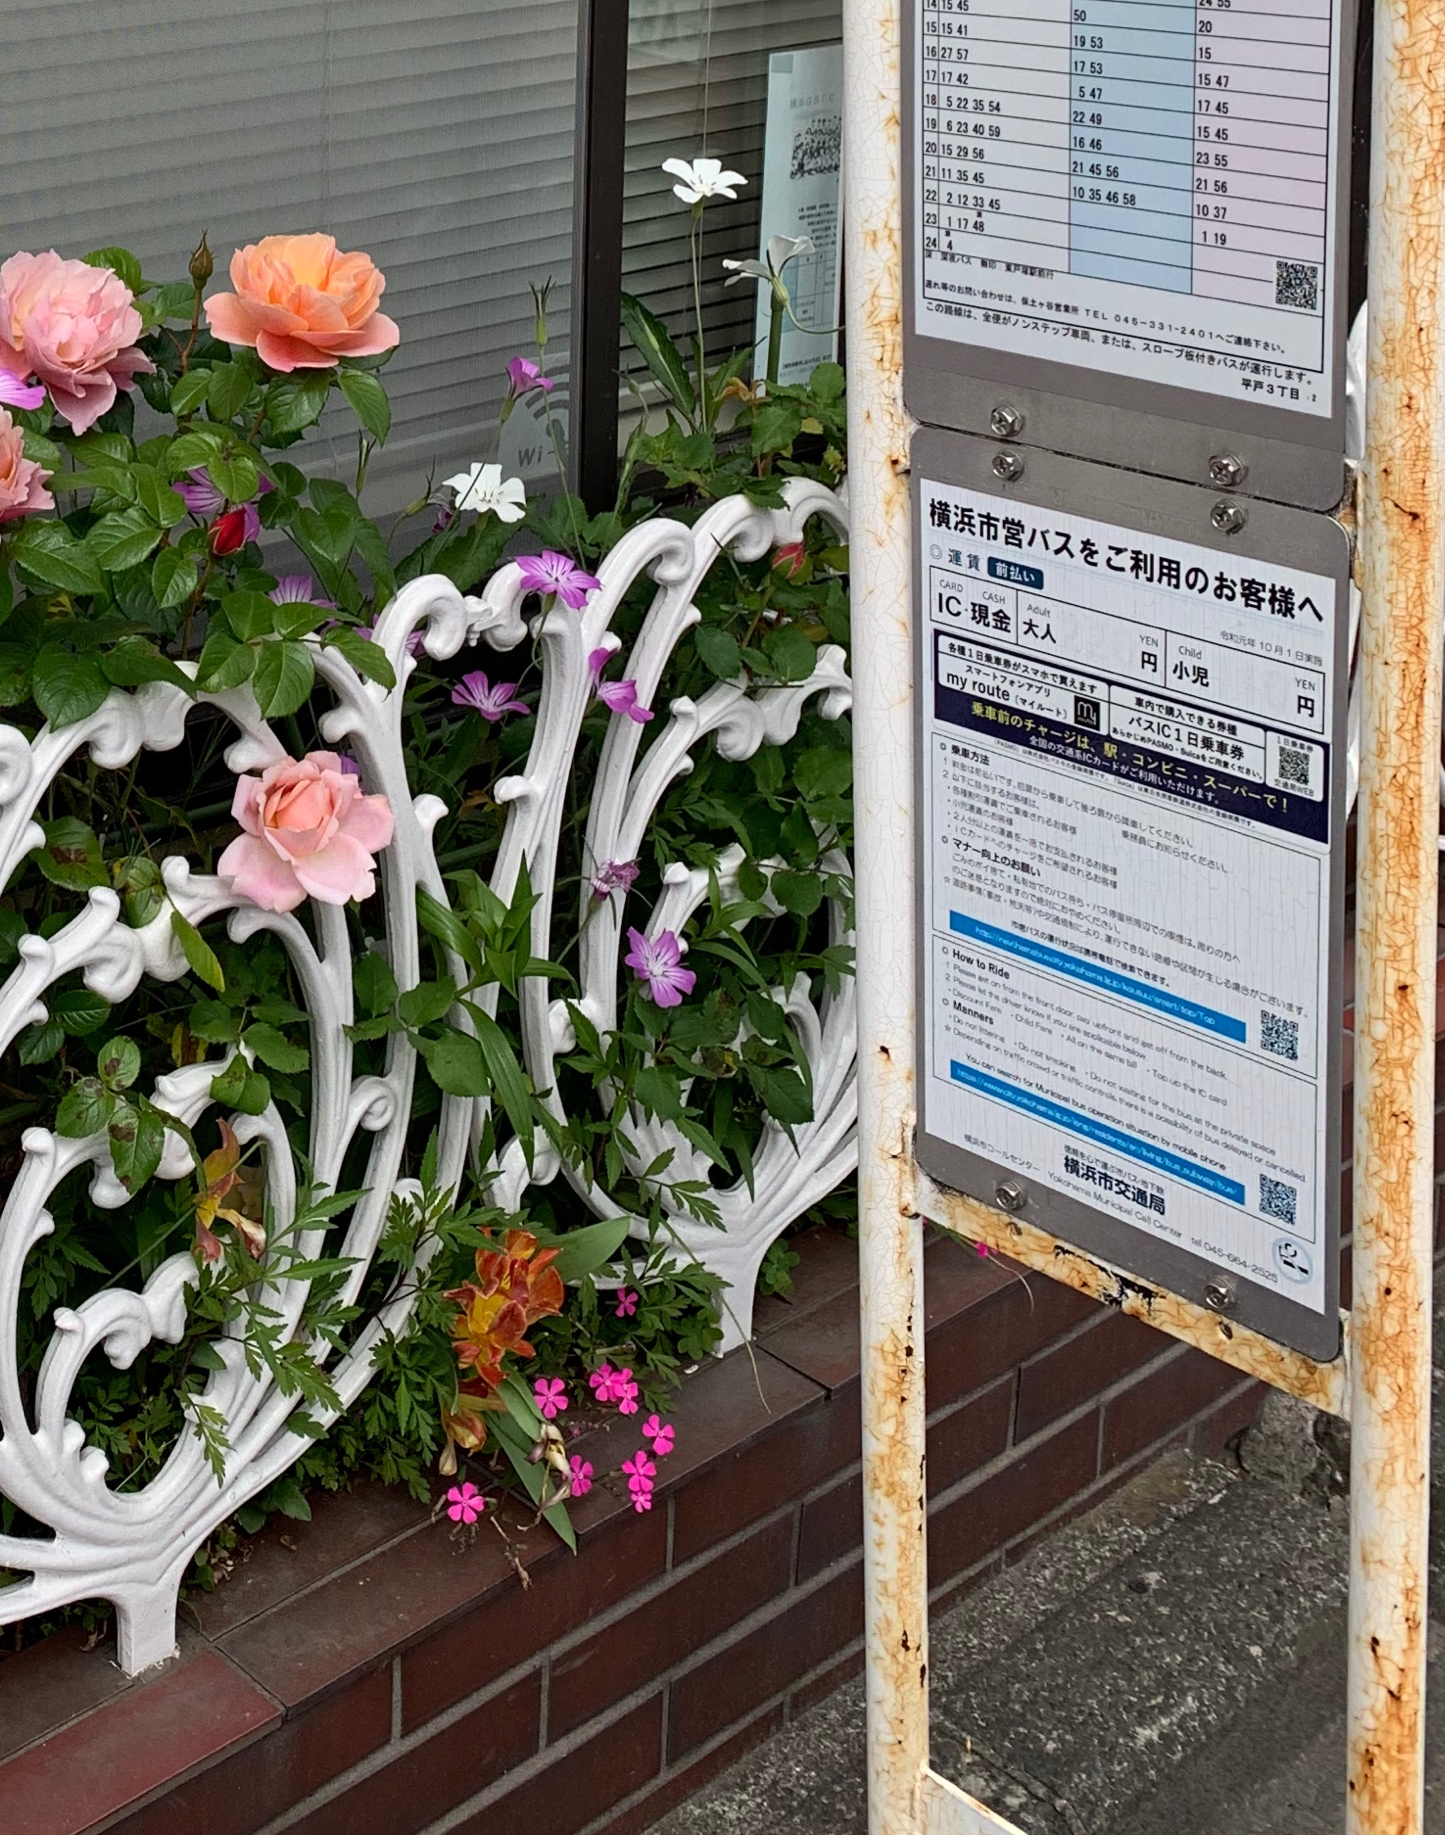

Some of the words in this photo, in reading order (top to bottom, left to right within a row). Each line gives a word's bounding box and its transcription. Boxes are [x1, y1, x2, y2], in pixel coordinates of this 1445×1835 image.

[926, 165, 936, 177] 21
[942, 168, 952, 179] 11
[957, 170, 969, 182] 35
[973, 172, 985, 184] 45
[1073, 186, 1084, 198] 10
[1089, 189, 1101, 201] 35
[1106, 191, 1119, 203] 46
[1123, 193, 1136, 206] 58
[1196, 204, 1209, 216] 10
[1213, 206, 1227, 219] 37
[1084, 308, 1108, 321] TEL
[1241, 377, 1300, 400] 平戸3丁目
[929, 498, 1324, 623] 横浜市営バスをご利用のお客様へ
[995, 561, 1035, 583] 前払い
[939, 579, 964, 592] CARD
[982, 591, 1006, 604] CASH
[1026, 603, 1051, 618] Adult
[1022, 618, 1057, 644] 大人
[1139, 634, 1159, 648] YEN
[1141, 650, 1157, 673] 円
[1178, 645, 1202, 660] Child
[965, 664, 1051, 698] スマートフォンアプリ
[1172, 660, 1210, 688] 小児
[1294, 677, 1316, 691] YEN
[946, 672, 968, 690] my
[972, 679, 1010, 702] route
[1297, 695, 1315, 718] 円
[951, 744, 990, 767] 乗車方法
[952, 837, 1041, 877] マナー向上のお願い
[952, 948, 974, 966] How
[976, 958, 986, 970] to
[988, 961, 1010, 980] Ride
[953, 1000, 994, 1026] Manners
[1063, 1154, 1166, 1217] 横浜市交通局
[1191, 1235, 1203, 1249] tel
